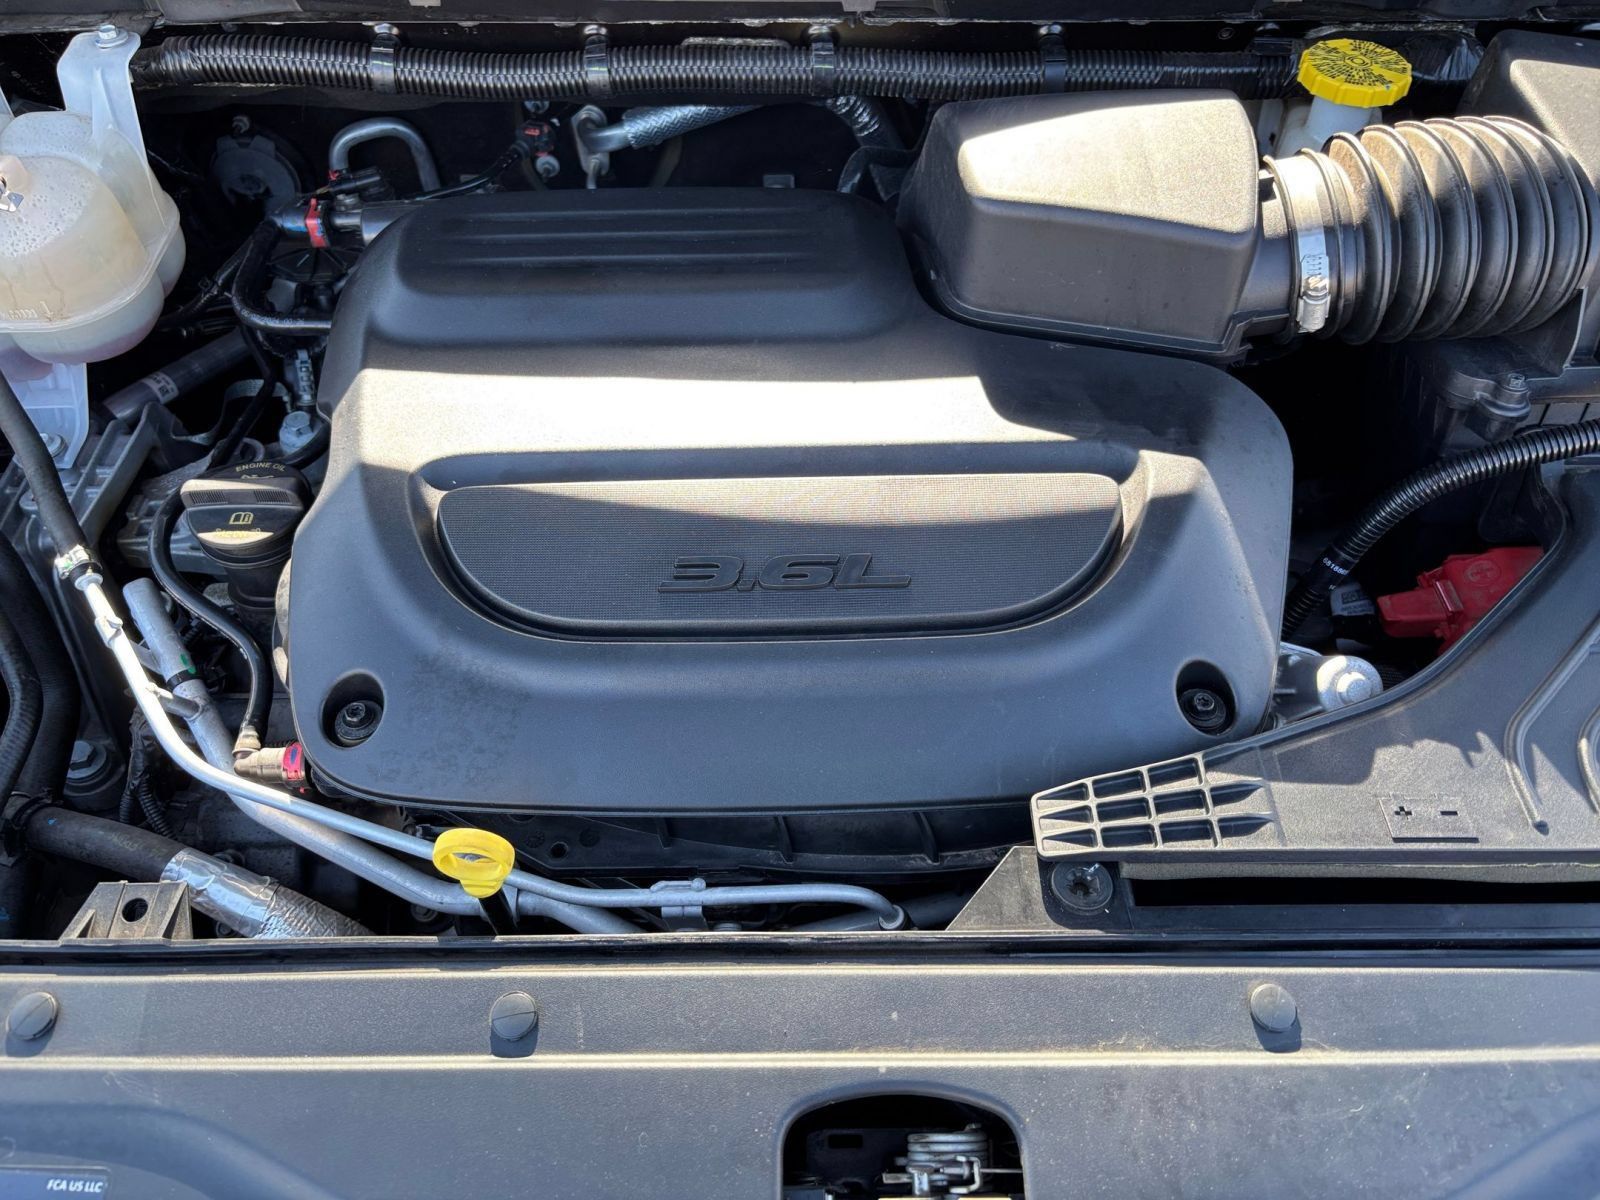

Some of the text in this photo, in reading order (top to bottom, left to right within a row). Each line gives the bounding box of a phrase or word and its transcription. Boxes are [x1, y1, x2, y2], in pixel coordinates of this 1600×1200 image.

[235, 462, 286, 472] ENGINE OIL
[658, 552, 912, 593] 3.6L
[46, 1178, 104, 1193] FCA US LLC
